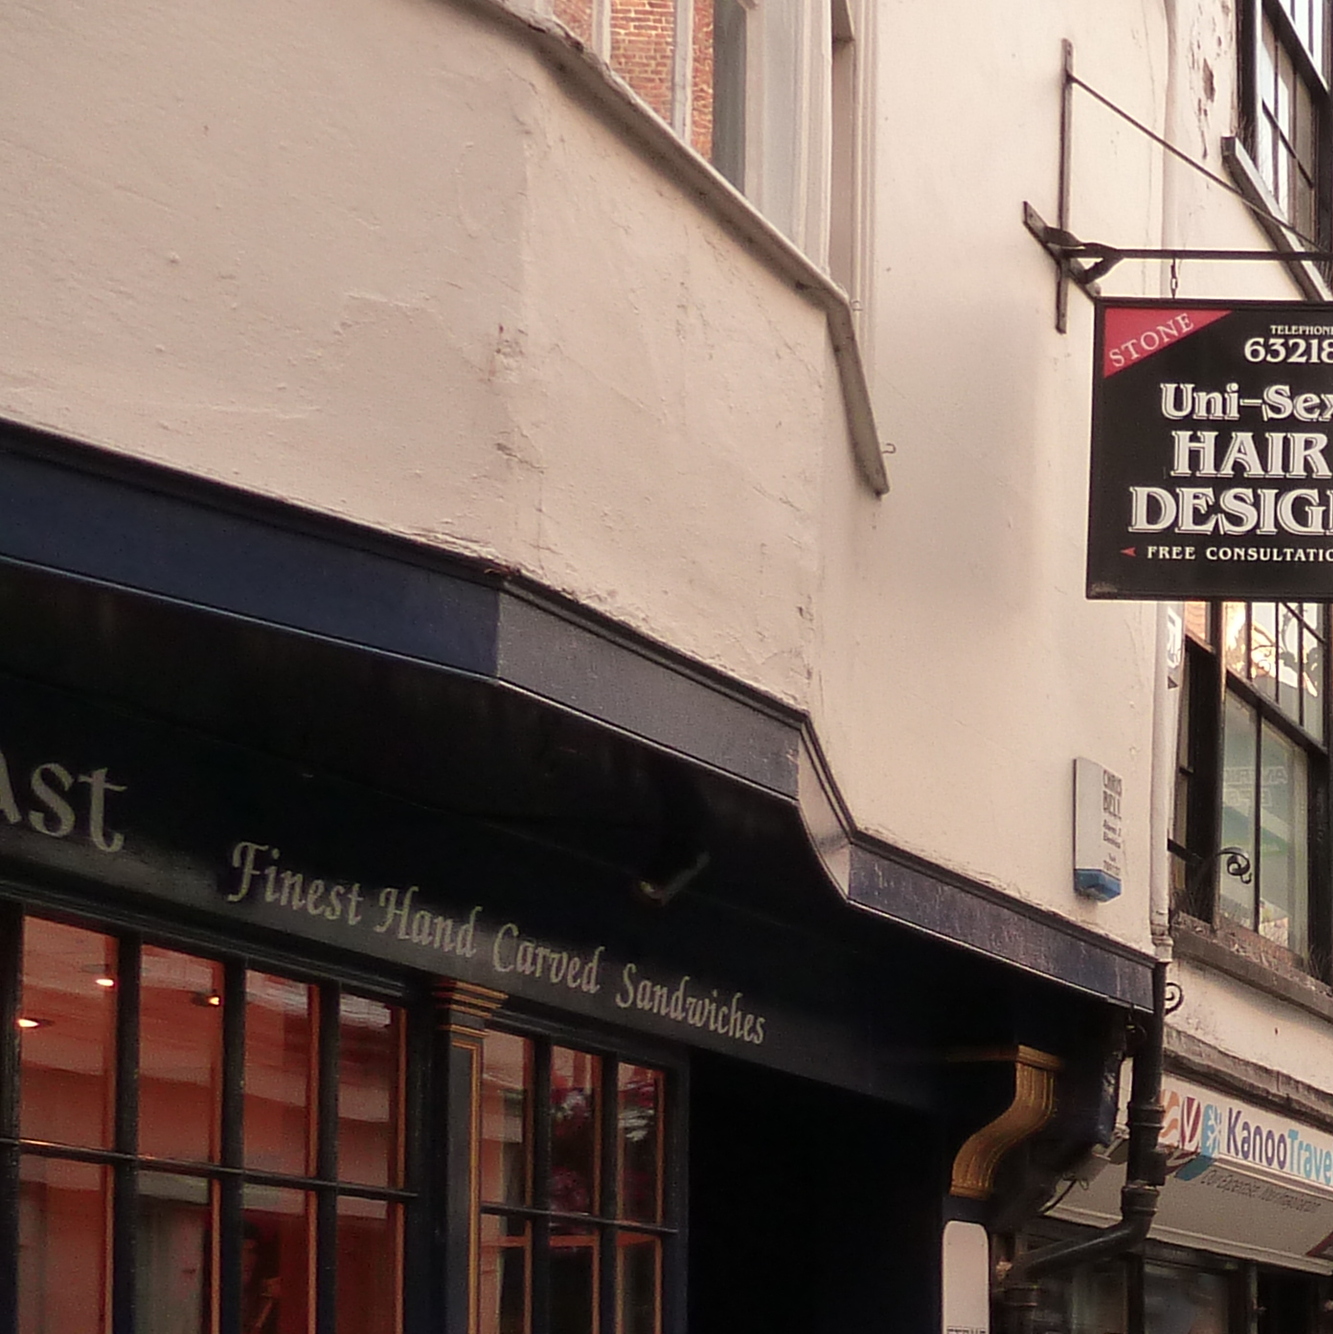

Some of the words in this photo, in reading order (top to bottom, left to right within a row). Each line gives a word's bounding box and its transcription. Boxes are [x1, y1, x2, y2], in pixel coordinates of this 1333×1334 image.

[1109, 312, 1193, 368] STONE
[1170, 430, 1333, 478] HAIR
[1147, 546, 1196, 560] FREE
[228, 839, 364, 927] Finest
[374, 886, 483, 959] Hand
[491, 922, 604, 996] Carved
[614, 962, 767, 1045] Sandwiches
